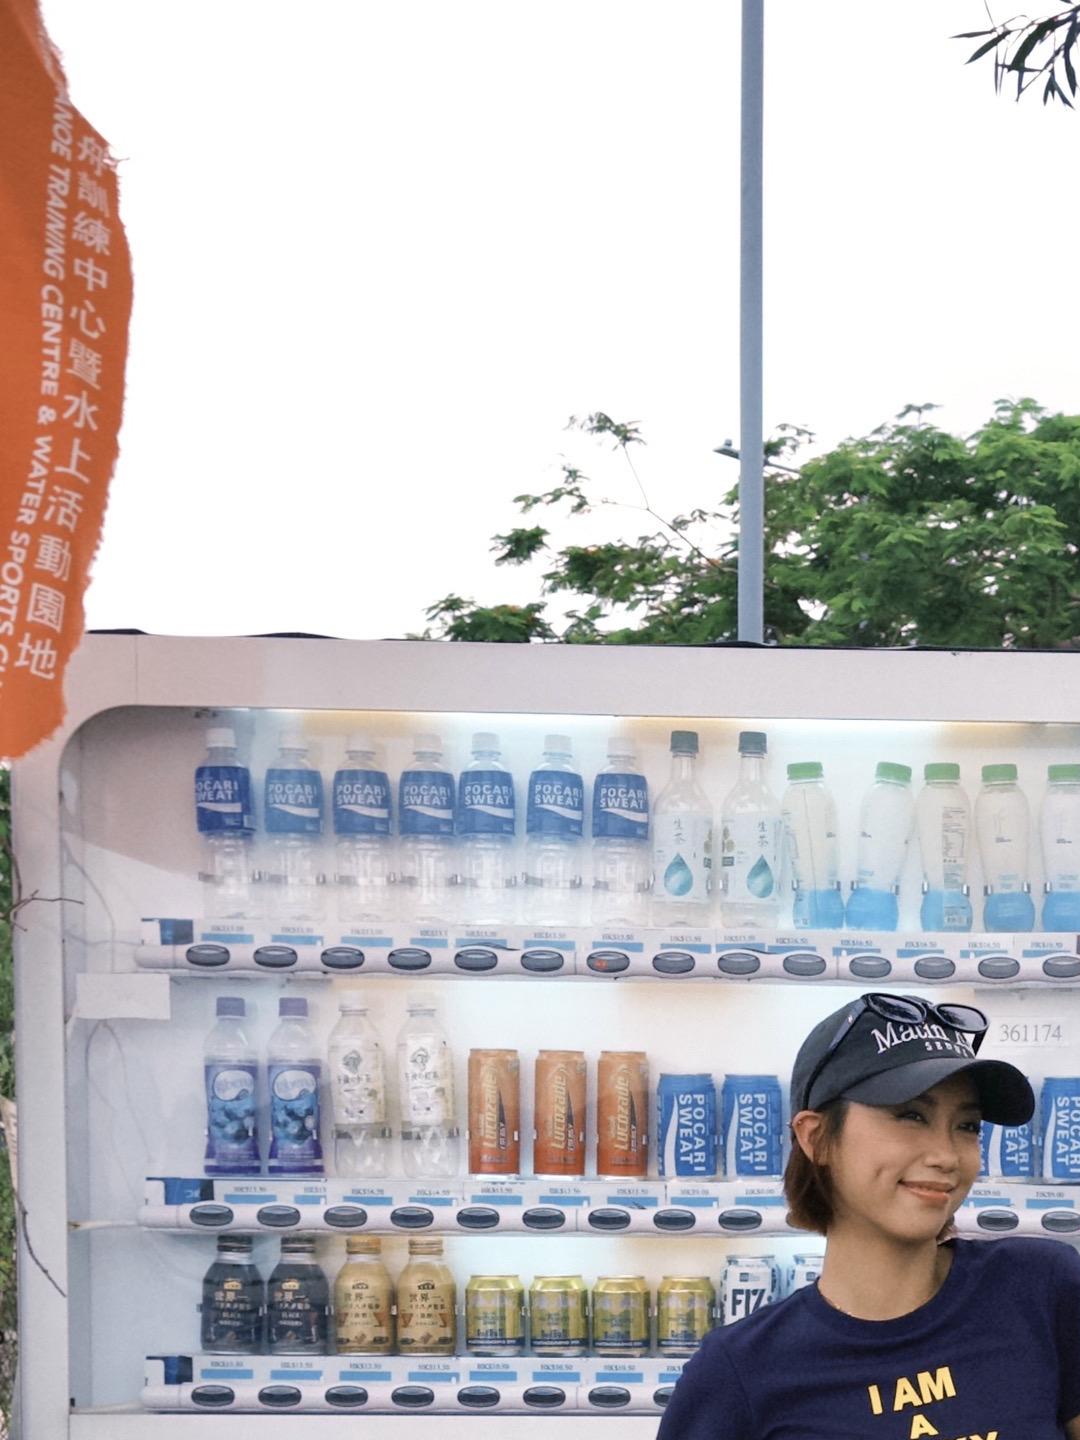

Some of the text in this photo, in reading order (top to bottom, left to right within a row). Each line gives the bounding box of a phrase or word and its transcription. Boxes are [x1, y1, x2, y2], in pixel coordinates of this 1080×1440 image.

[43, 164, 70, 281] TRAINING
[40, 284, 65, 397] CENTRE
[37, 405, 58, 425] &
[16, 435, 53, 526] WATER
[0, 531, 31, 637] SPORTS
[197, 780, 239, 790] OCARI
[268, 784, 317, 795] POCARI
[336, 784, 386, 795] POCARI
[403, 784, 451, 796] POCARI
[464, 784, 512, 796] POCARI
[534, 784, 582, 797] POCARI
[599, 787, 648, 799] POCARI
[268, 794, 314, 805] SWEAT
[336, 794, 383, 805] SWEAT
[403, 794, 447, 806] SWEAT
[464, 794, 509, 806] SWEAT
[534, 793, 579, 806] SWEAT
[599, 797, 643, 809] SWEAT
[871, 1021, 950, 1054] Matin
[999, 1024, 1063, 1042] 361174
[679, 1094, 694, 1165] SWEAT
[693, 1094, 705, 1171] POCARI
[739, 1094, 754, 1164] SWEAT
[754, 1094, 767, 1171] POCARI
[1057, 1096, 1069, 1166] SWEAT
[1005, 1129, 1019, 1164] EAT
[1017, 1125, 1029, 1171] CARI
[868, 1366, 957, 1415] I AM
[910, 1414, 939, 1440] A
